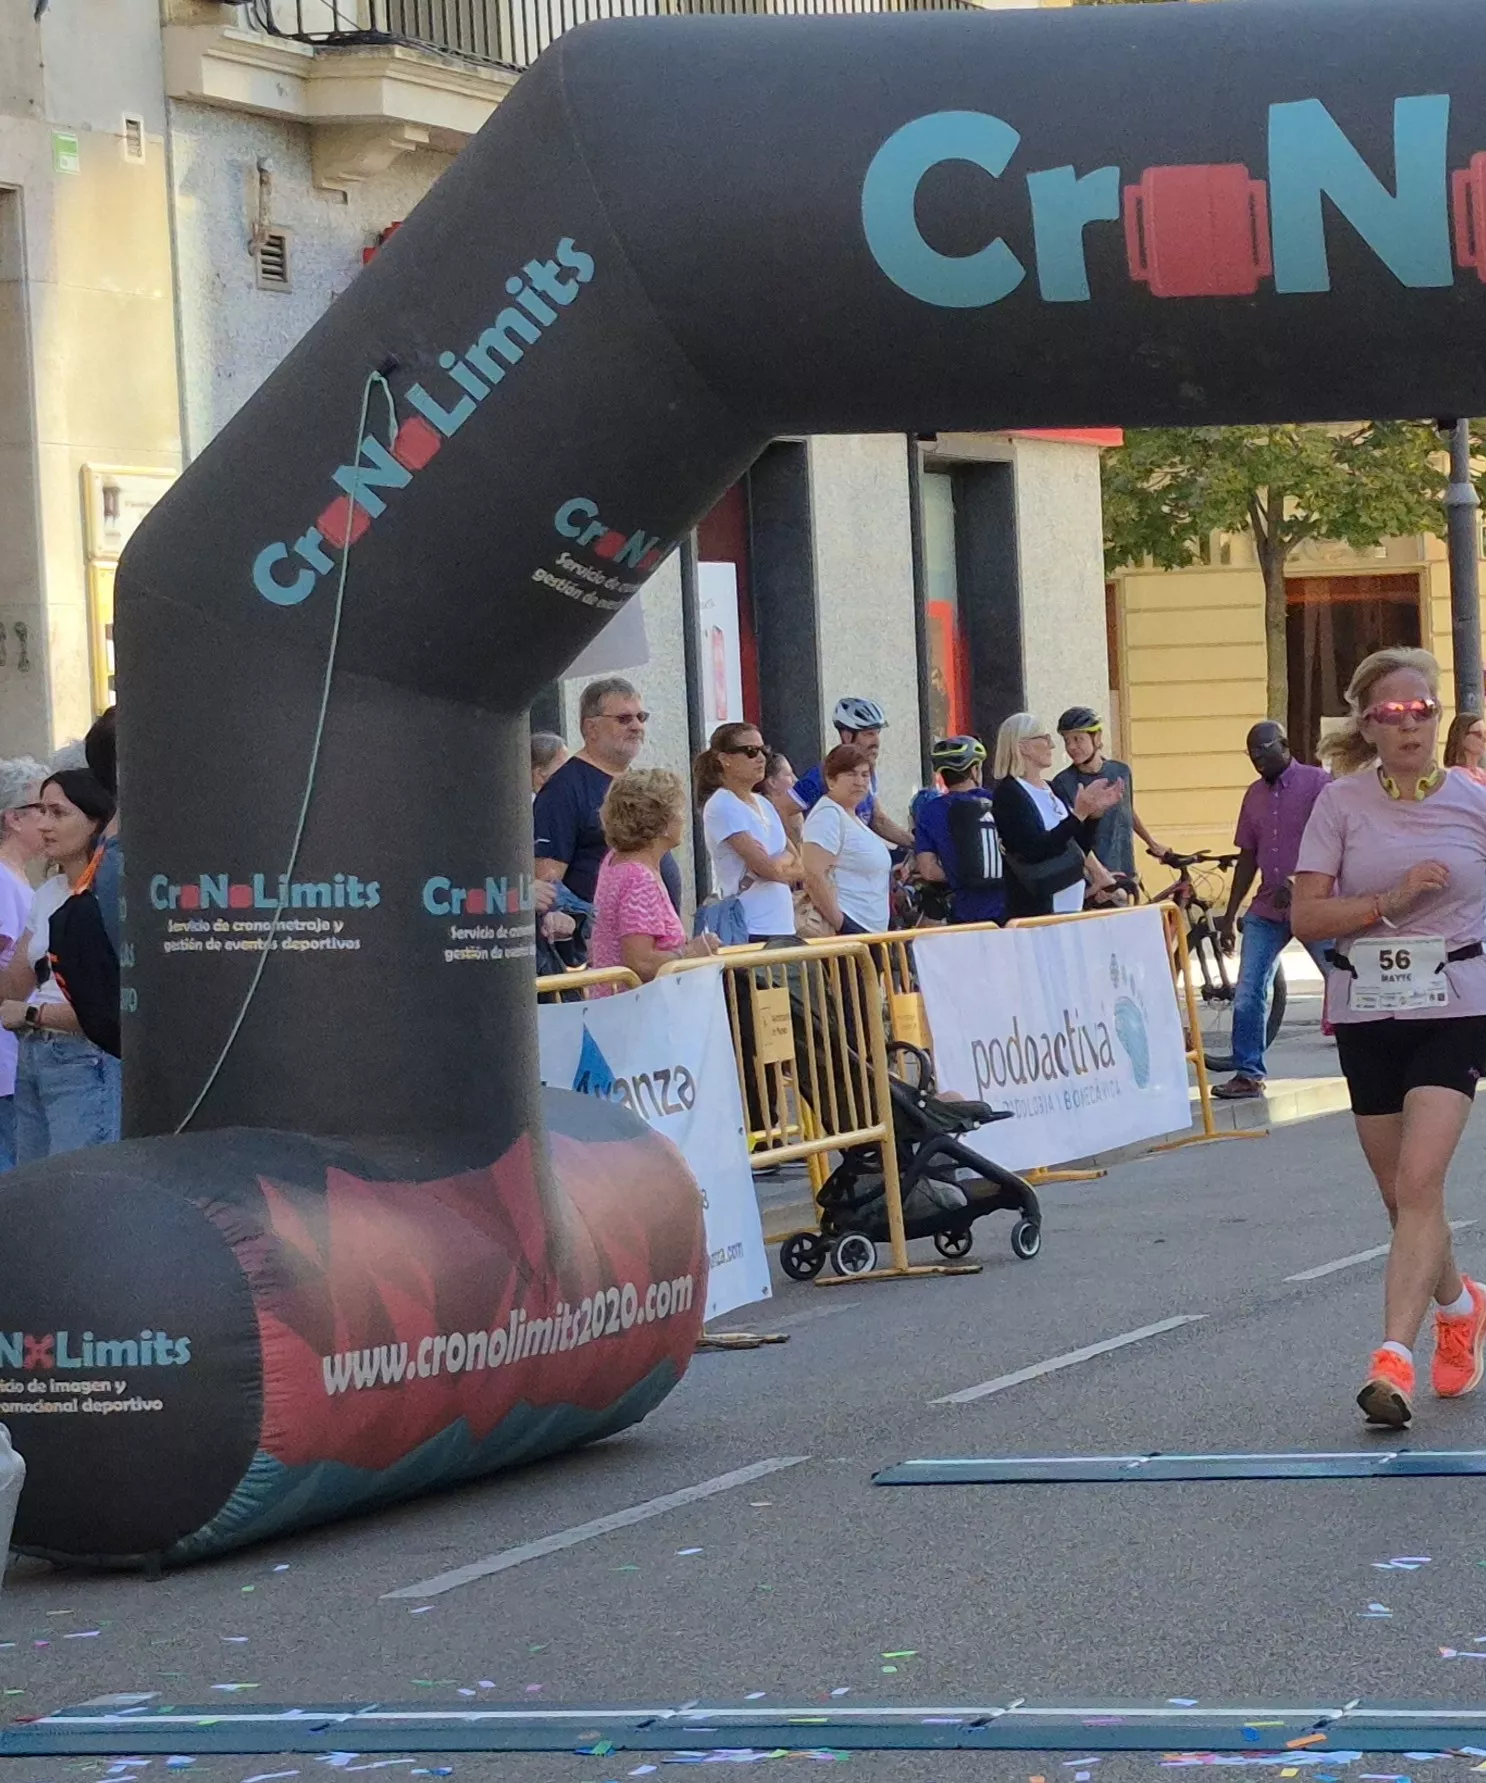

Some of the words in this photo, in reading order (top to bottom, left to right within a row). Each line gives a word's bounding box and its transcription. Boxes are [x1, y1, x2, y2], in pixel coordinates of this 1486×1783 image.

[1379, 949, 1411, 971] 56
[1381, 973, 1412, 983] MAYTE
[971, 1008, 1116, 1102] podoactiva
[322, 1274, 693, 1396] www.cronolimits2020.com
[27, 1377, 47, 1393] de
[50, 1378, 111, 1395] imagen
[114, 1380, 127, 1395] y
[81, 1396, 164, 1415] deportivo
